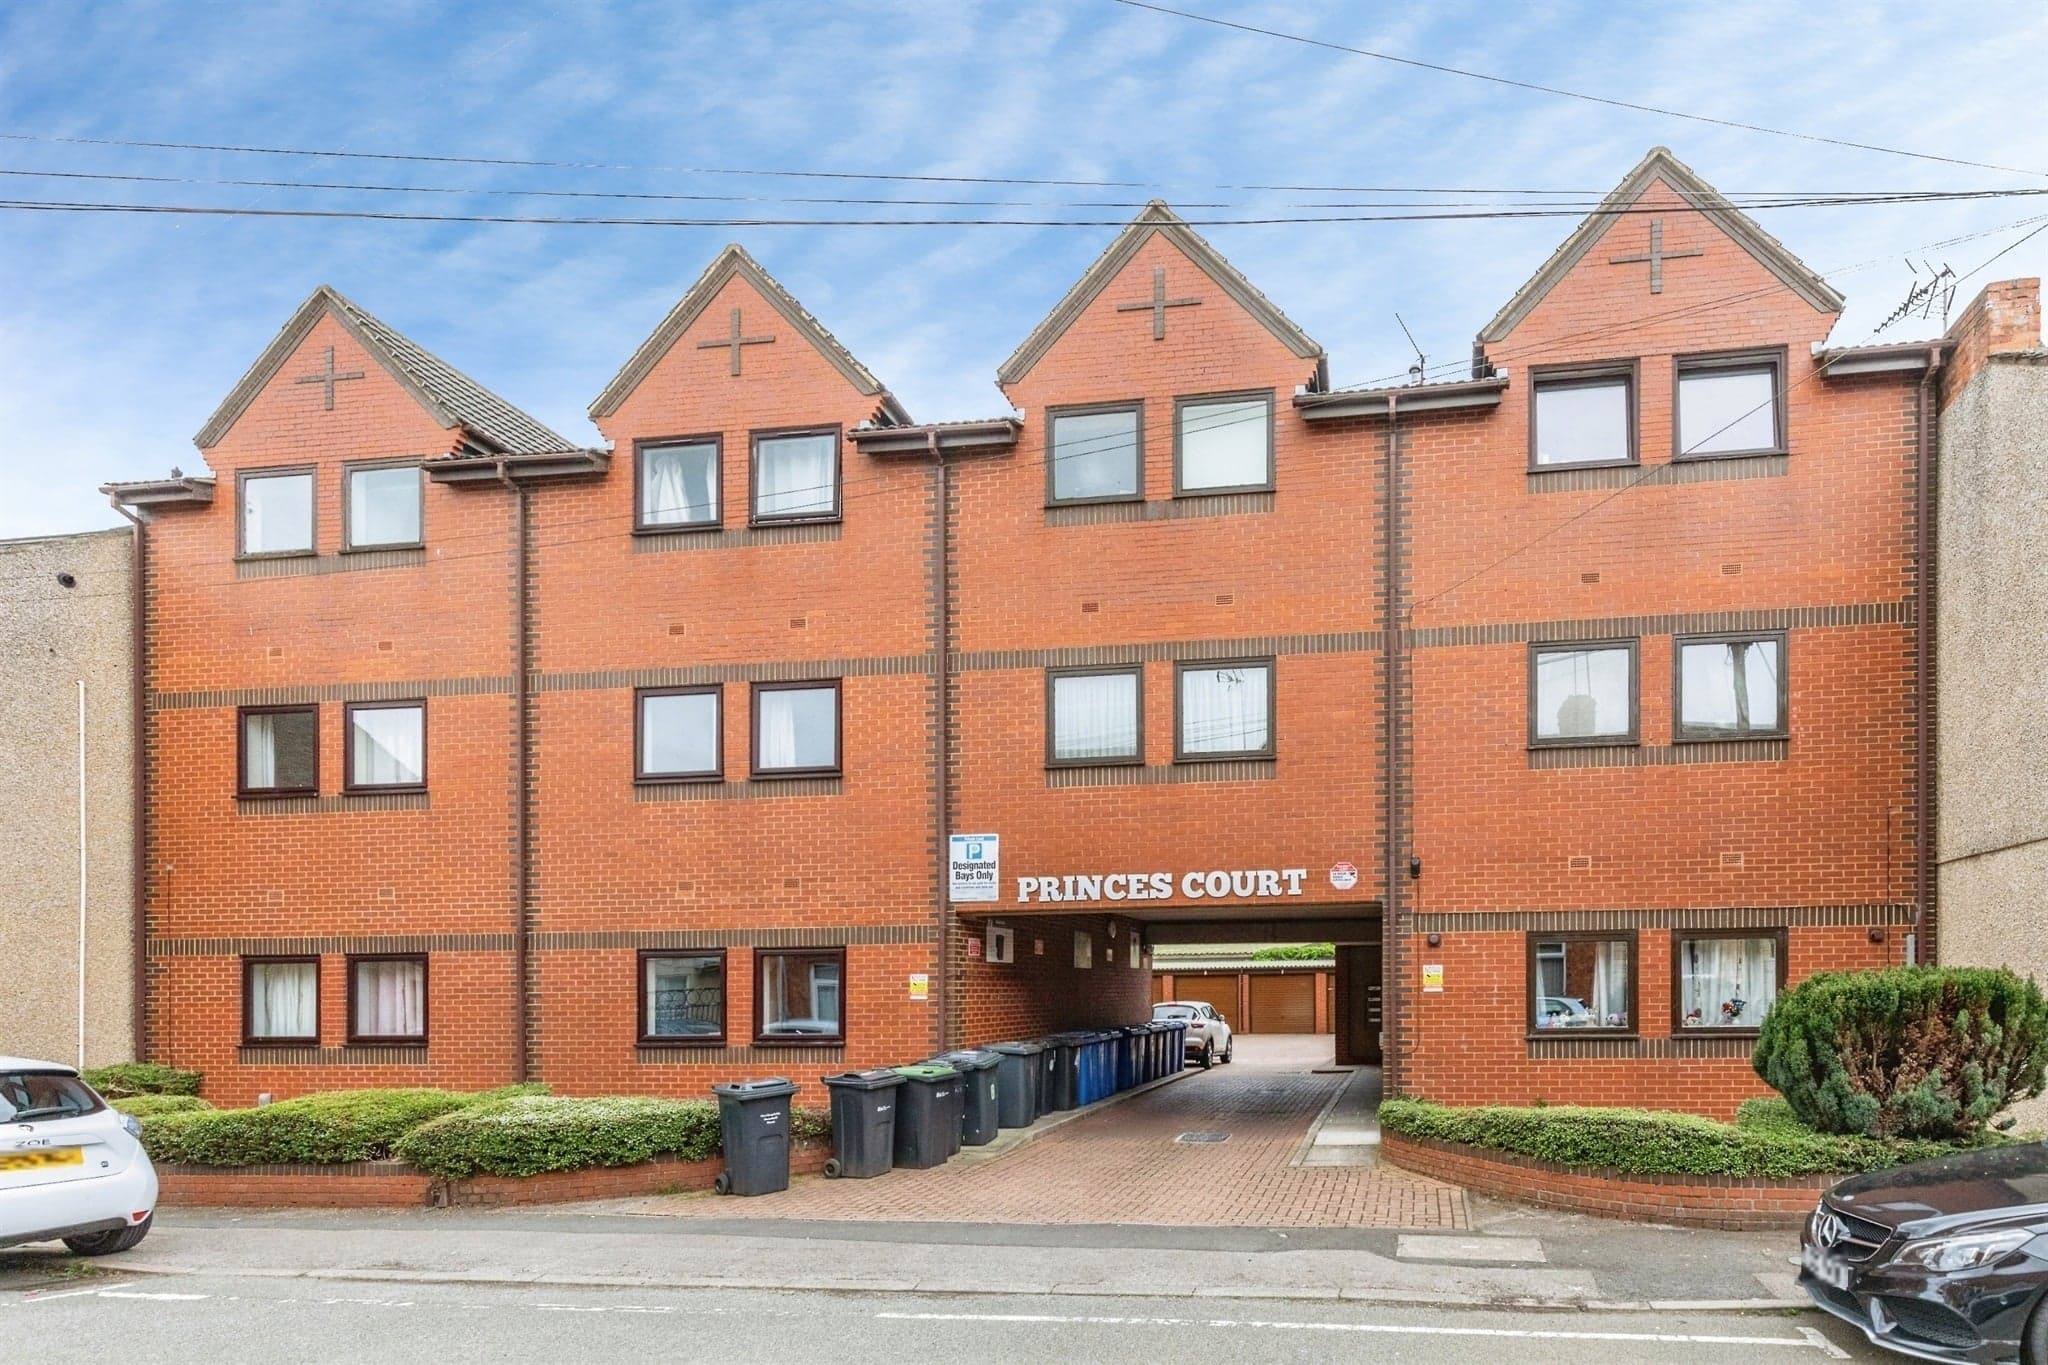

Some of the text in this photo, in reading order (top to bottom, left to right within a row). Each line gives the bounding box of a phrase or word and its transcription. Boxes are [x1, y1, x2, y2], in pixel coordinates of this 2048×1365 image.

[969, 843, 980, 859] P
[952, 861, 996, 871] Designated
[955, 870, 993, 881] Bays Only
[1017, 872, 1173, 903] PRINCES
[1181, 869, 1307, 898] COURT
